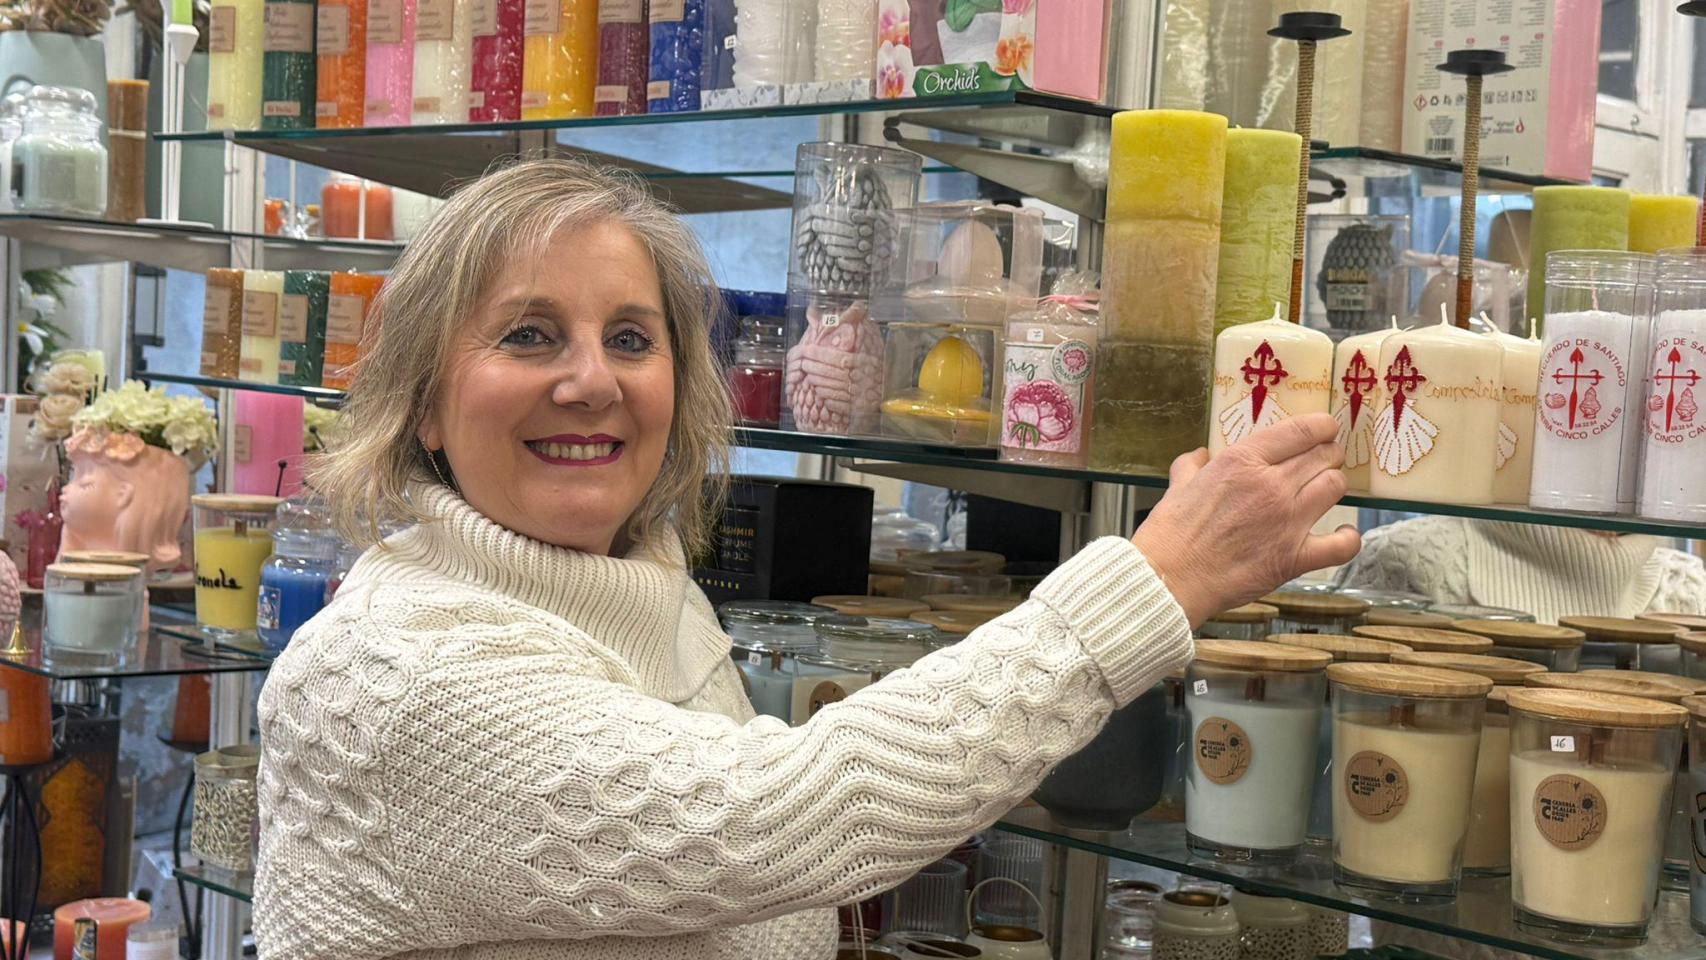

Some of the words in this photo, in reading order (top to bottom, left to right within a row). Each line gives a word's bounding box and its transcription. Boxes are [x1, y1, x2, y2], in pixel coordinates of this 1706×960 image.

[924, 68, 980, 93] Orchids
[1673, 338, 1687, 346] DE
[1576, 338, 1590, 347] DE
[1593, 342, 1626, 387] SANTIAGO
[1555, 429, 1588, 440] CINCO
[1592, 406, 1622, 435] CALLES
[1654, 431, 1684, 443] CINCO
[1554, 737, 1567, 749] 16
